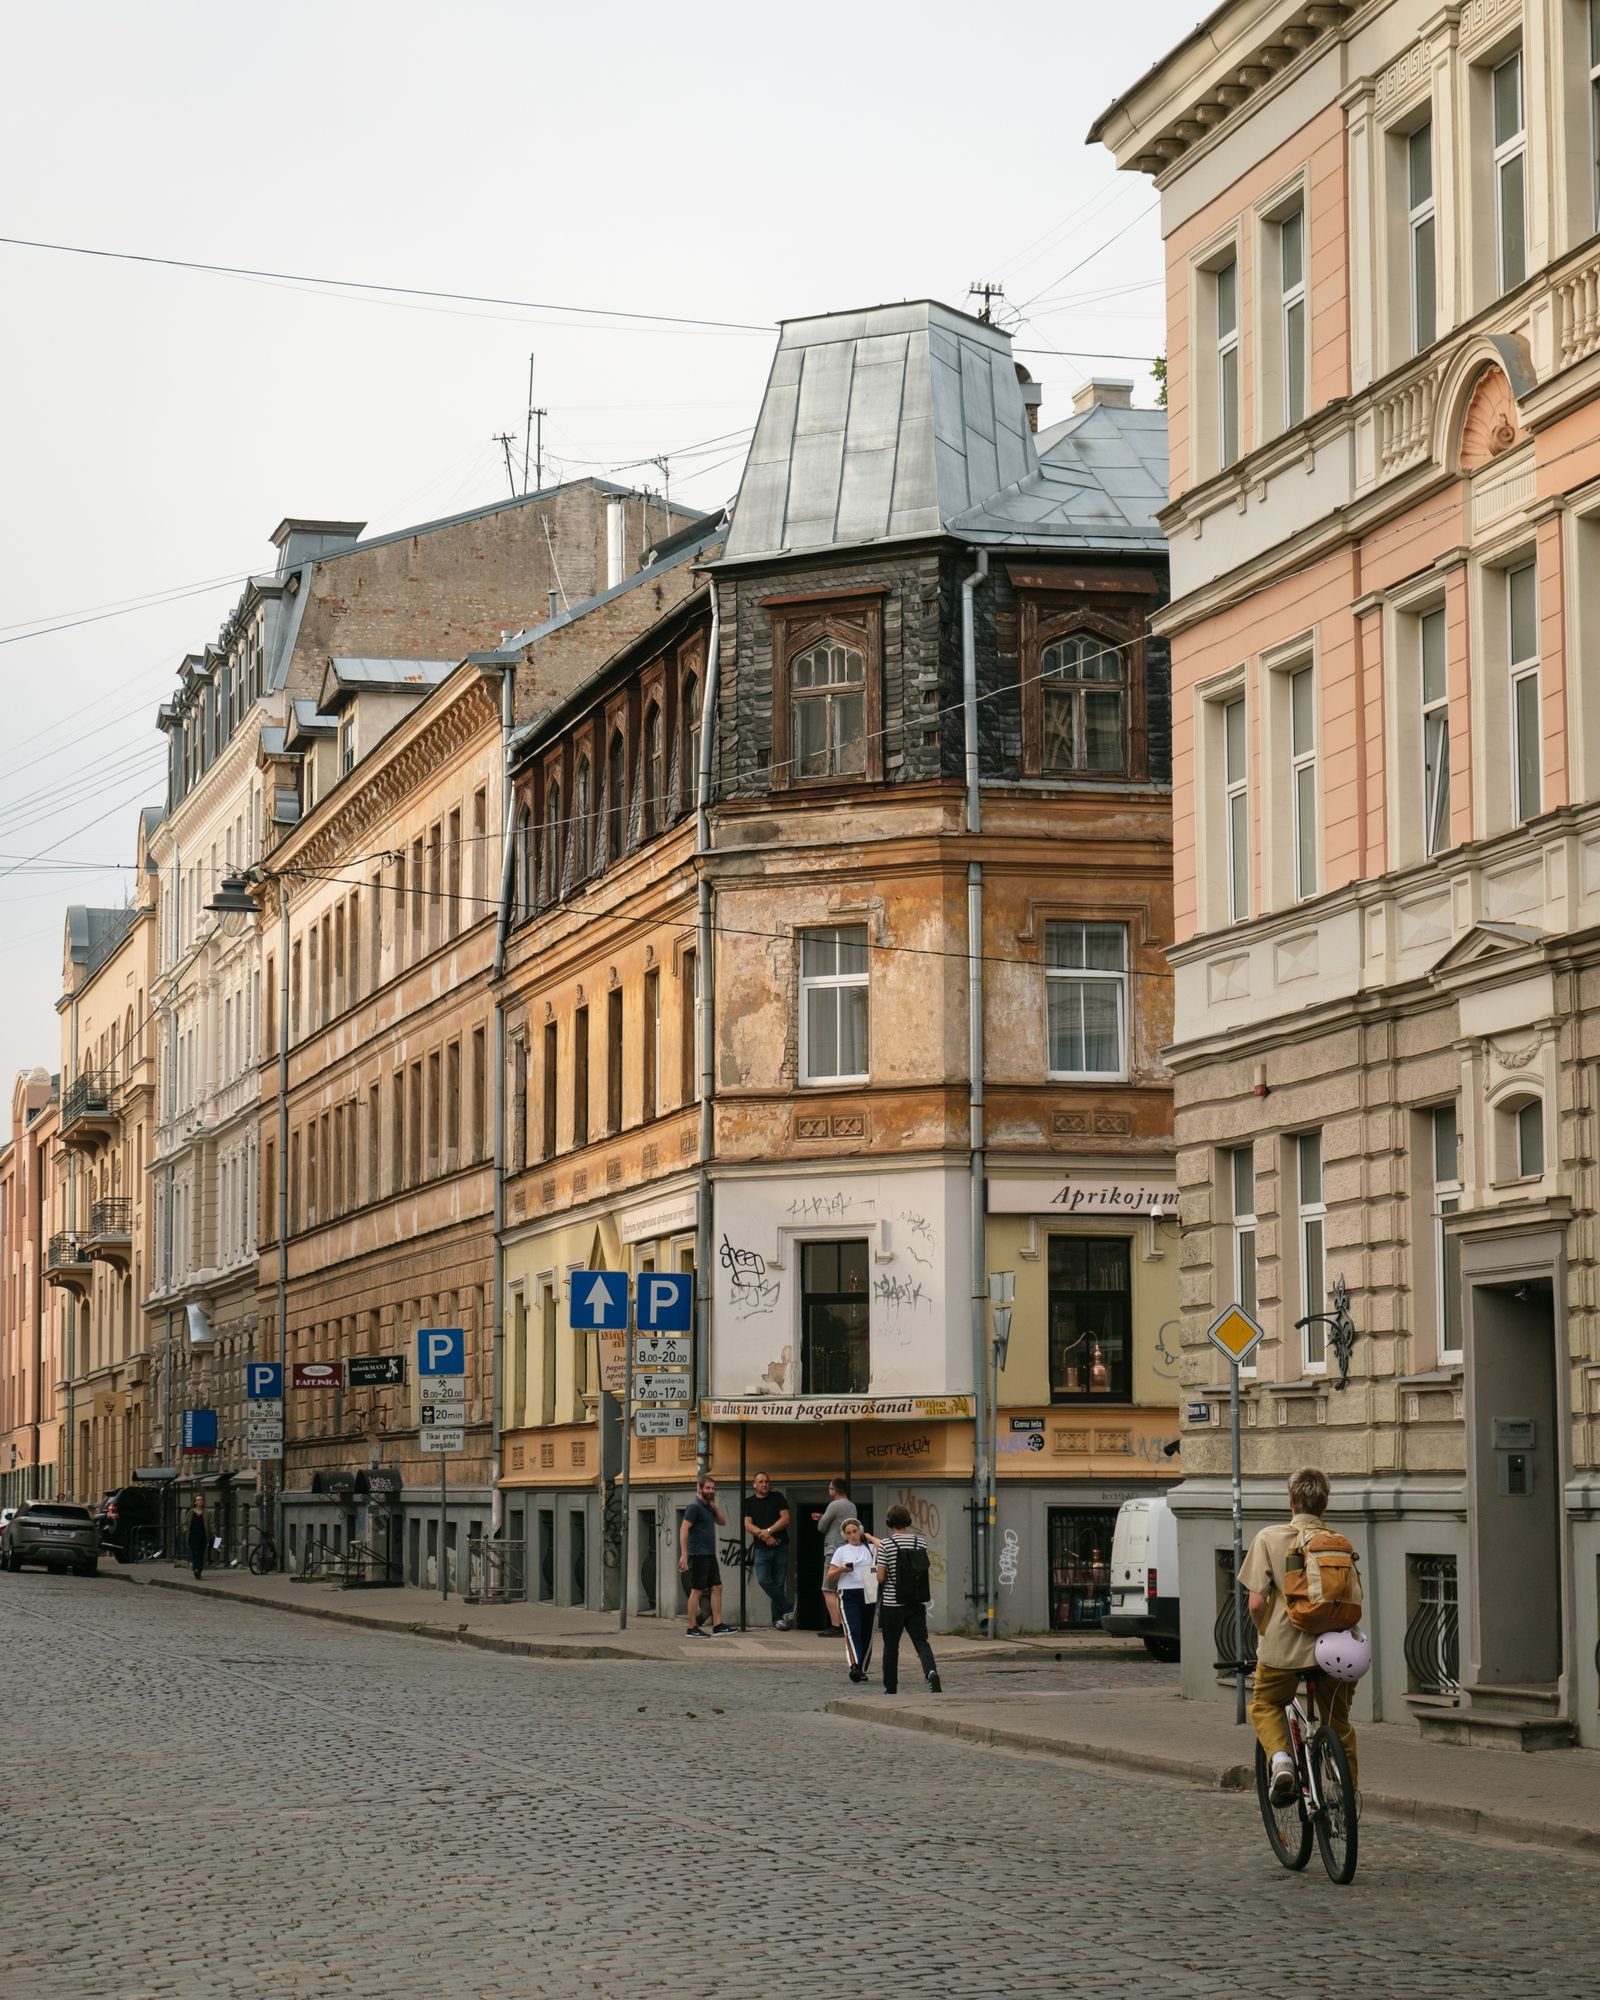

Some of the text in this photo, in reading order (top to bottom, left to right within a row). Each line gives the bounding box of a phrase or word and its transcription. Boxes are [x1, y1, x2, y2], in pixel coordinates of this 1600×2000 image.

[650, 1280, 679, 1324] P
[428, 1334, 453, 1370] P
[639, 1350, 687, 1363] 8.00-20.00
[255, 1367, 275, 1394] P
[423, 1388, 463, 1399] 8.00-20.00
[722, 1401, 740, 1415] alus
[743, 1405, 758, 1415] un
[761, 1403, 792, 1415] vīna
[795, 1400, 912, 1420] pagatavošanai
[675, 1418, 684, 1427] B
[443, 1433, 461, 1442] preču
